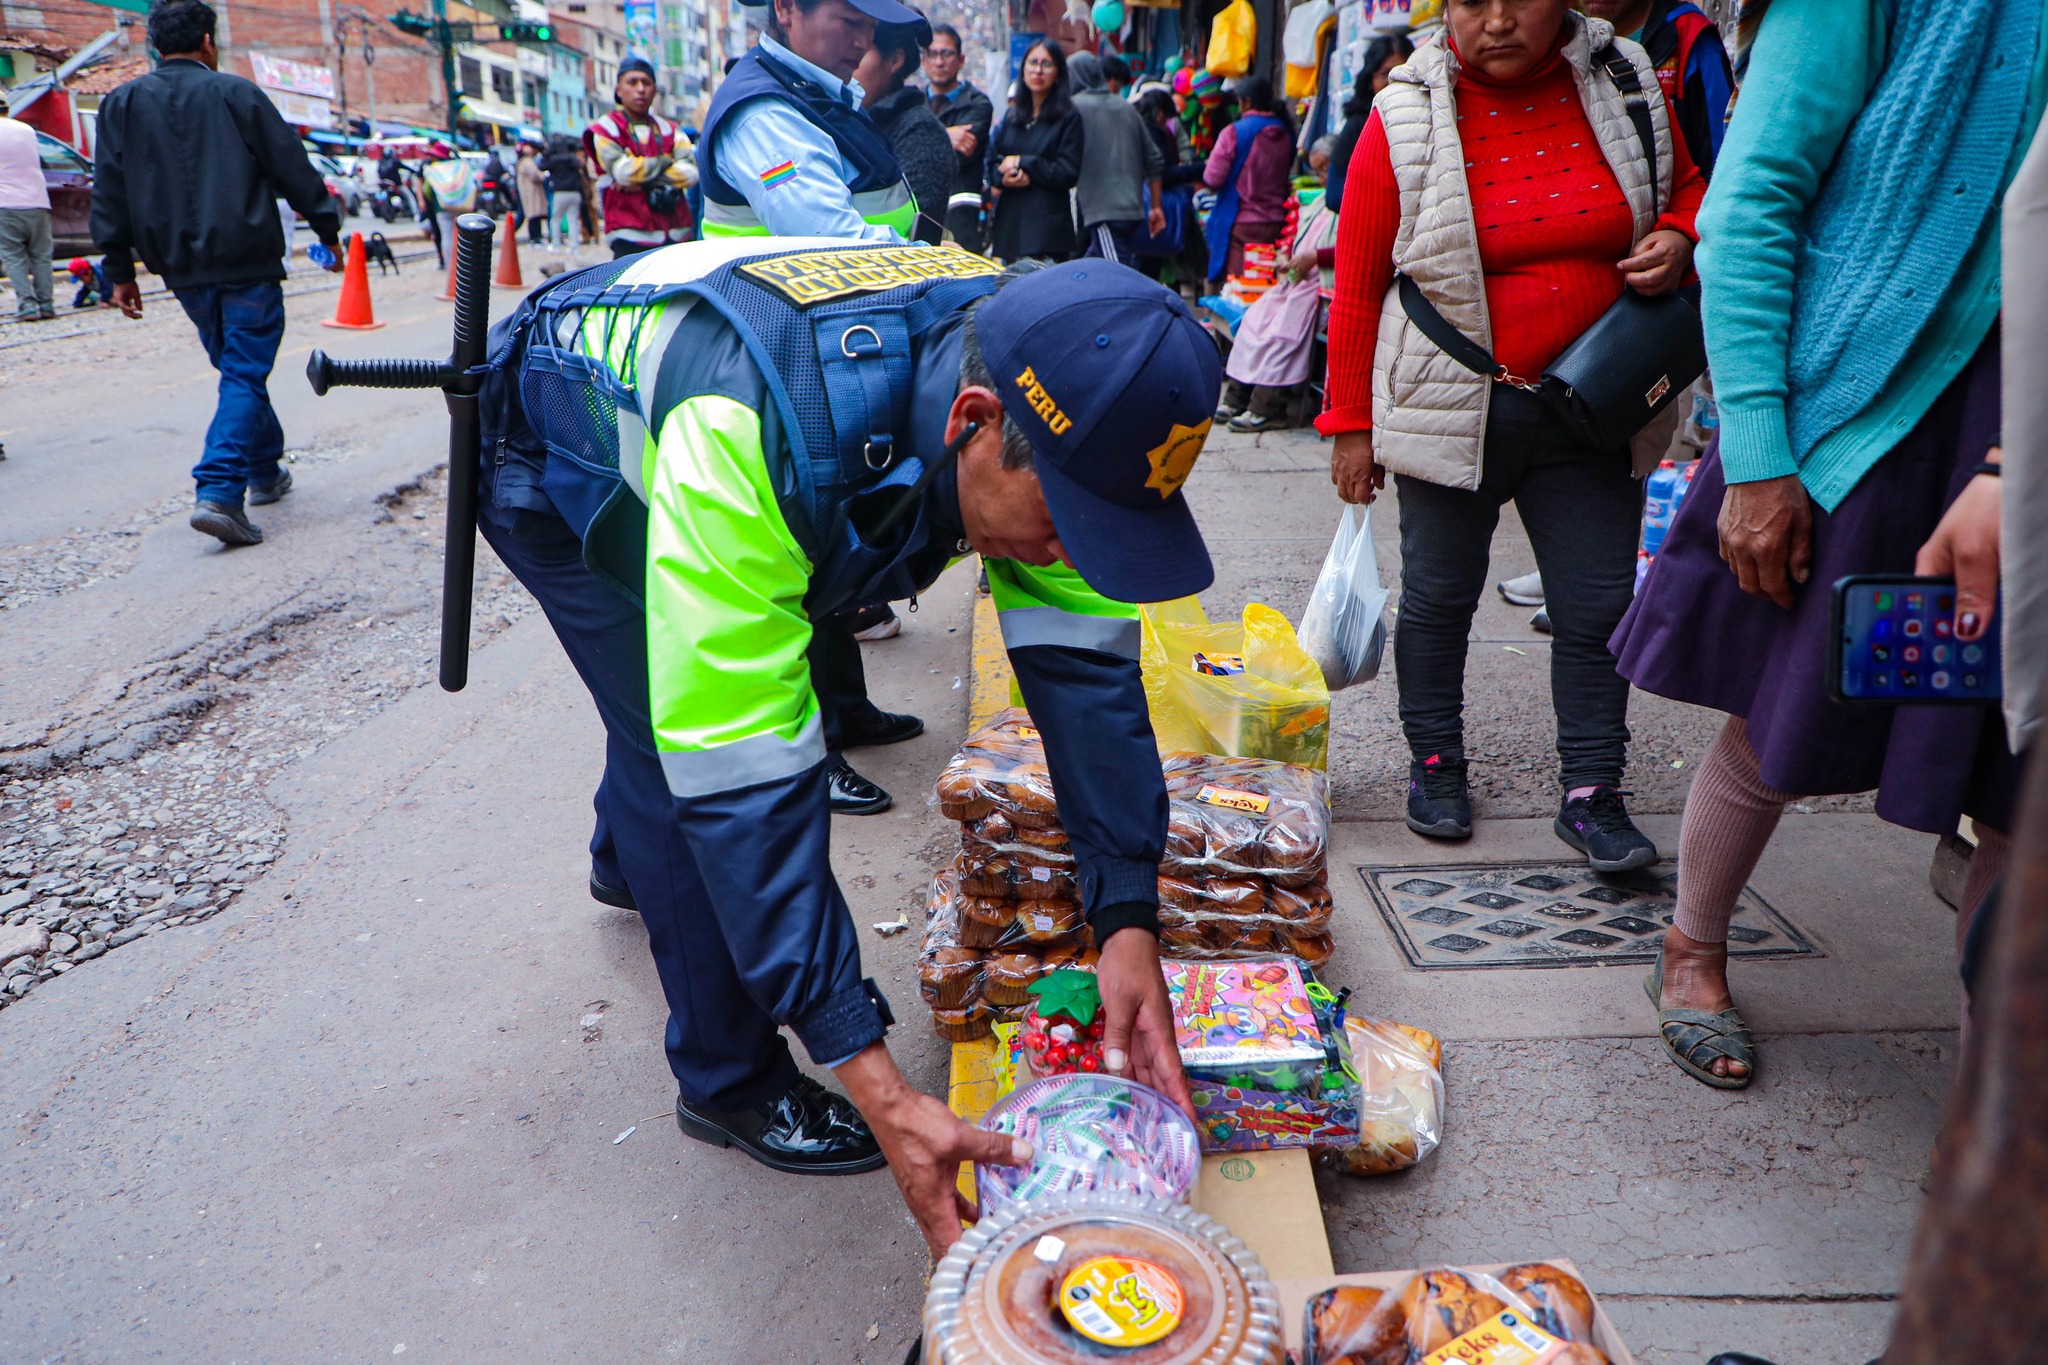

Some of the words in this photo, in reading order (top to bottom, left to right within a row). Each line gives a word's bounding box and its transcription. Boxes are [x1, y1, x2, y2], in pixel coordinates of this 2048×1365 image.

[759, 248, 967, 277] CIUDADANA
[786, 257, 991, 296] SEGURIDAD
[1015, 366, 1073, 435] PERU
